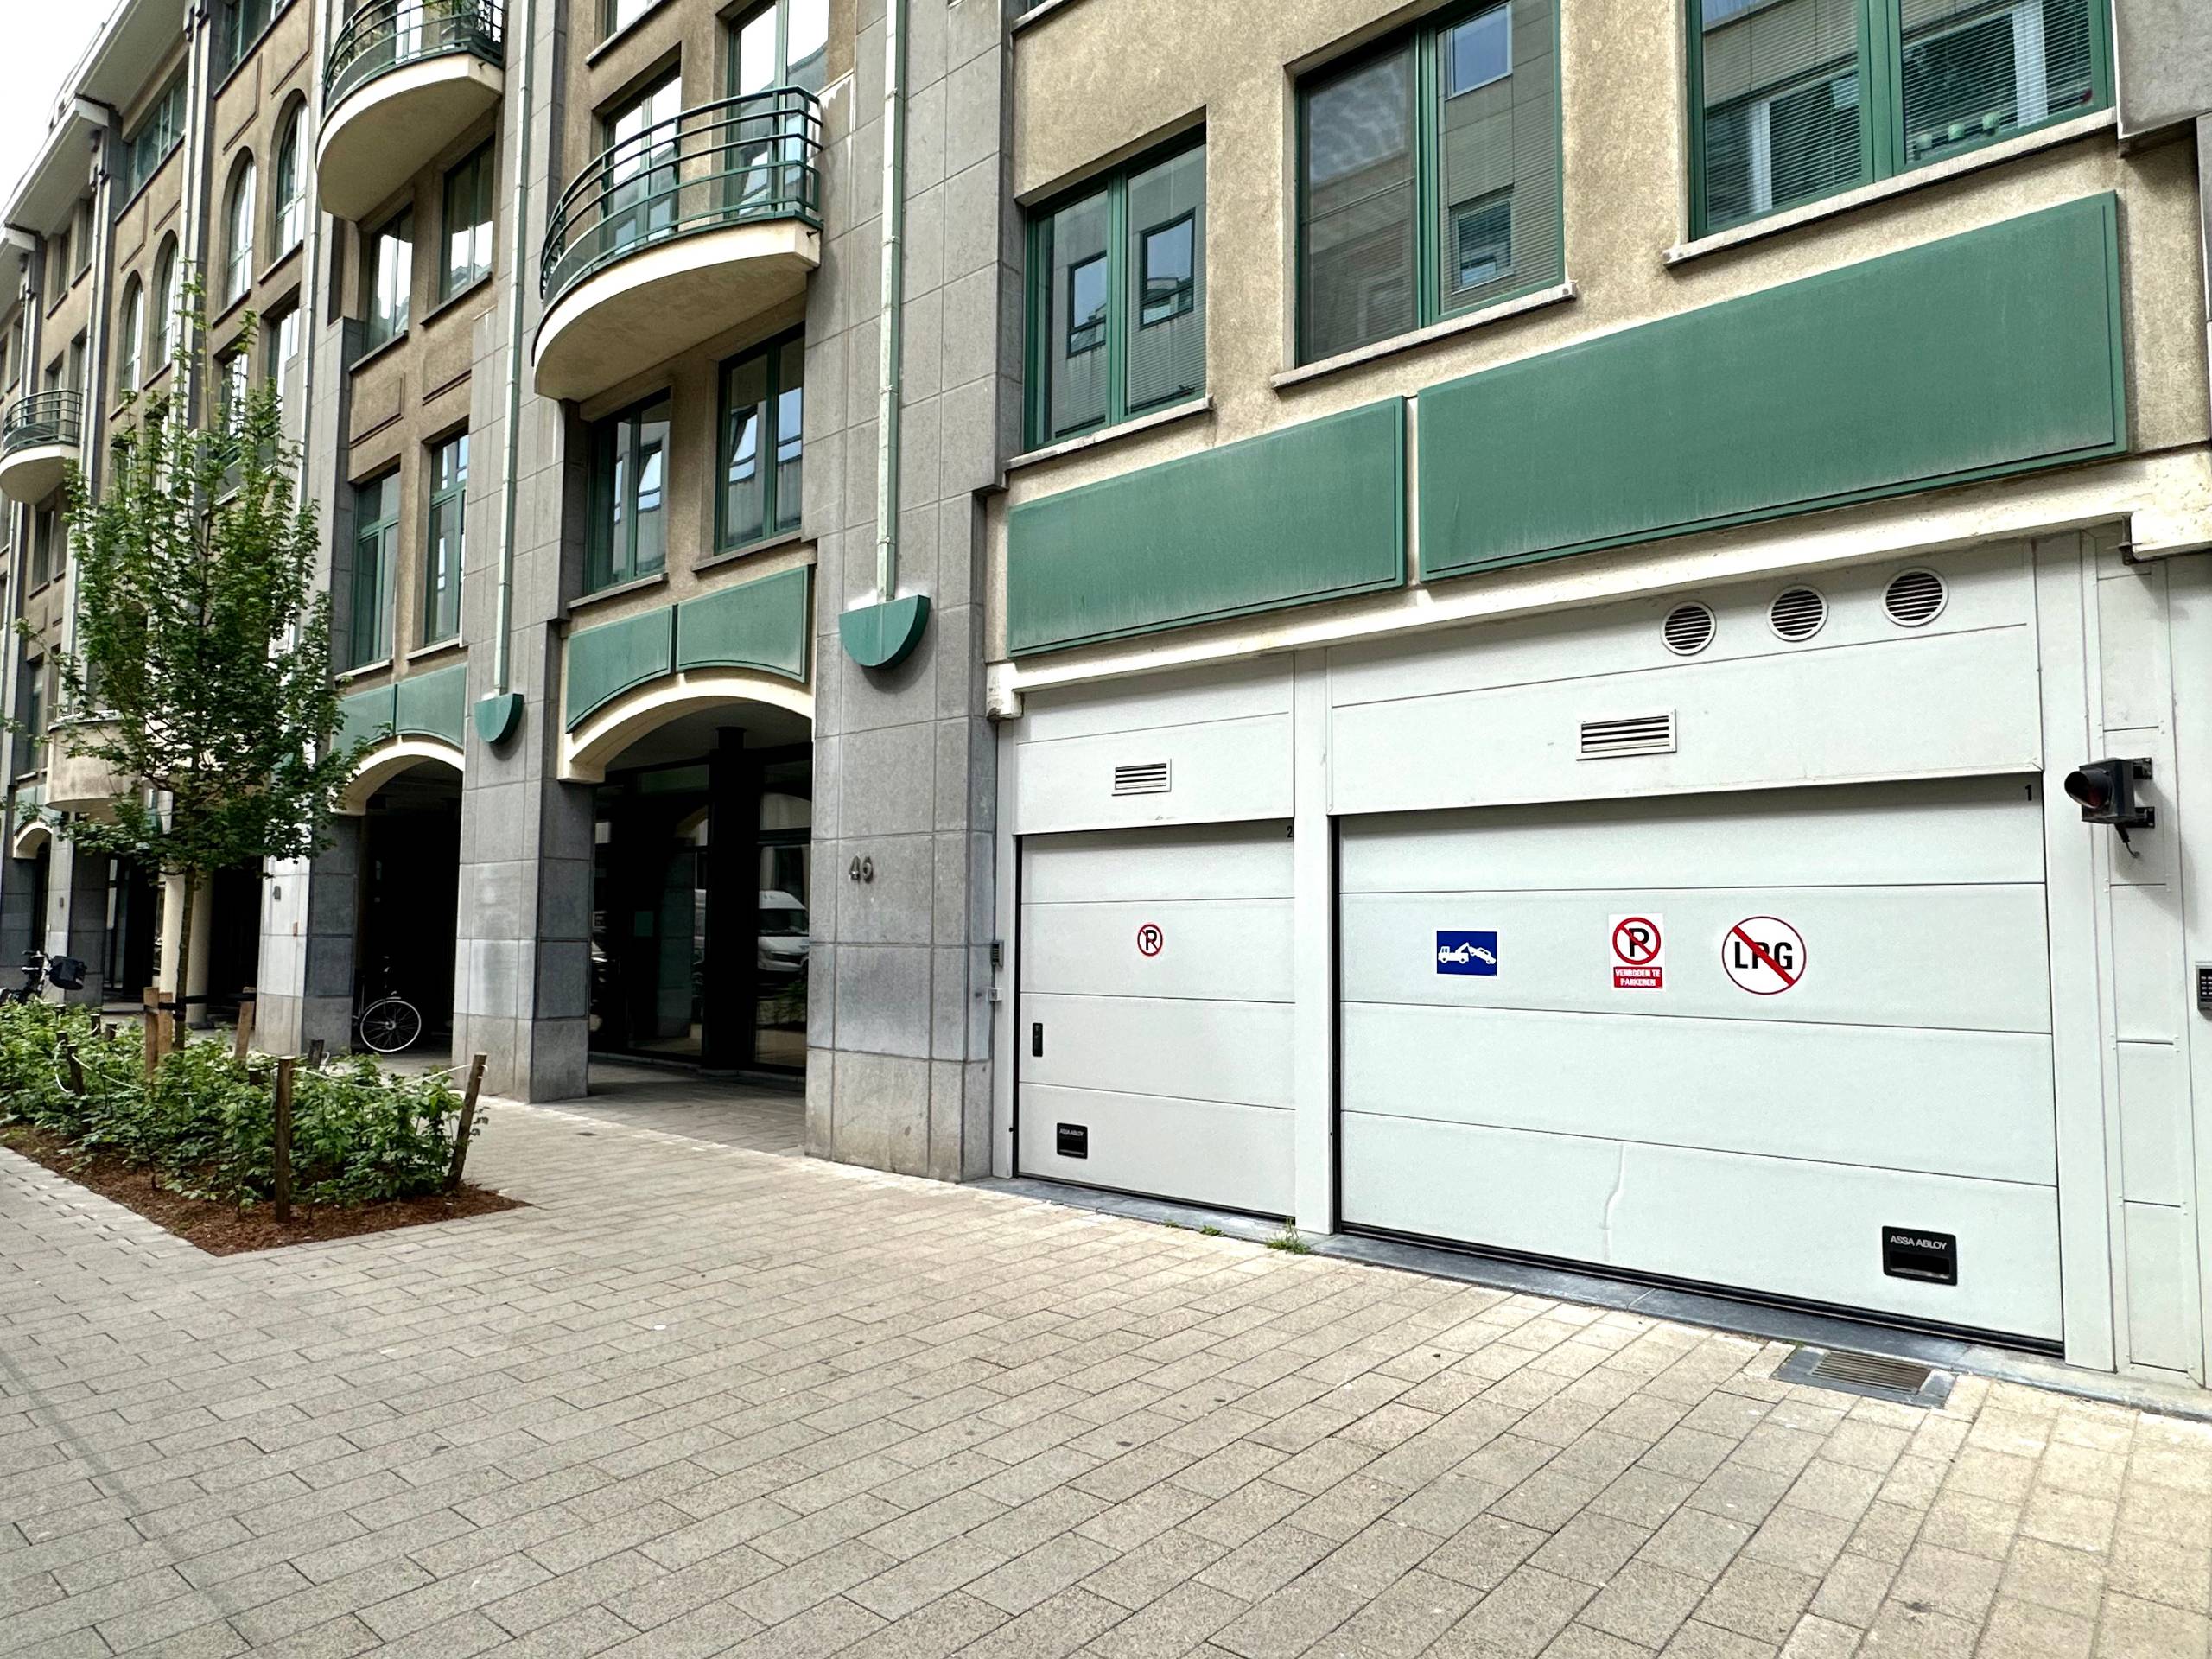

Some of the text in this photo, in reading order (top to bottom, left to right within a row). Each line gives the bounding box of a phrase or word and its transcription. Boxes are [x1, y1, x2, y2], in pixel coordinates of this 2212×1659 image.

[2024, 784, 2032, 801] 1
[1287, 825, 1294, 838] 2
[1734, 941, 1793, 970] LPG
[1890, 1235, 1948, 1250] ASSA ABLOY
